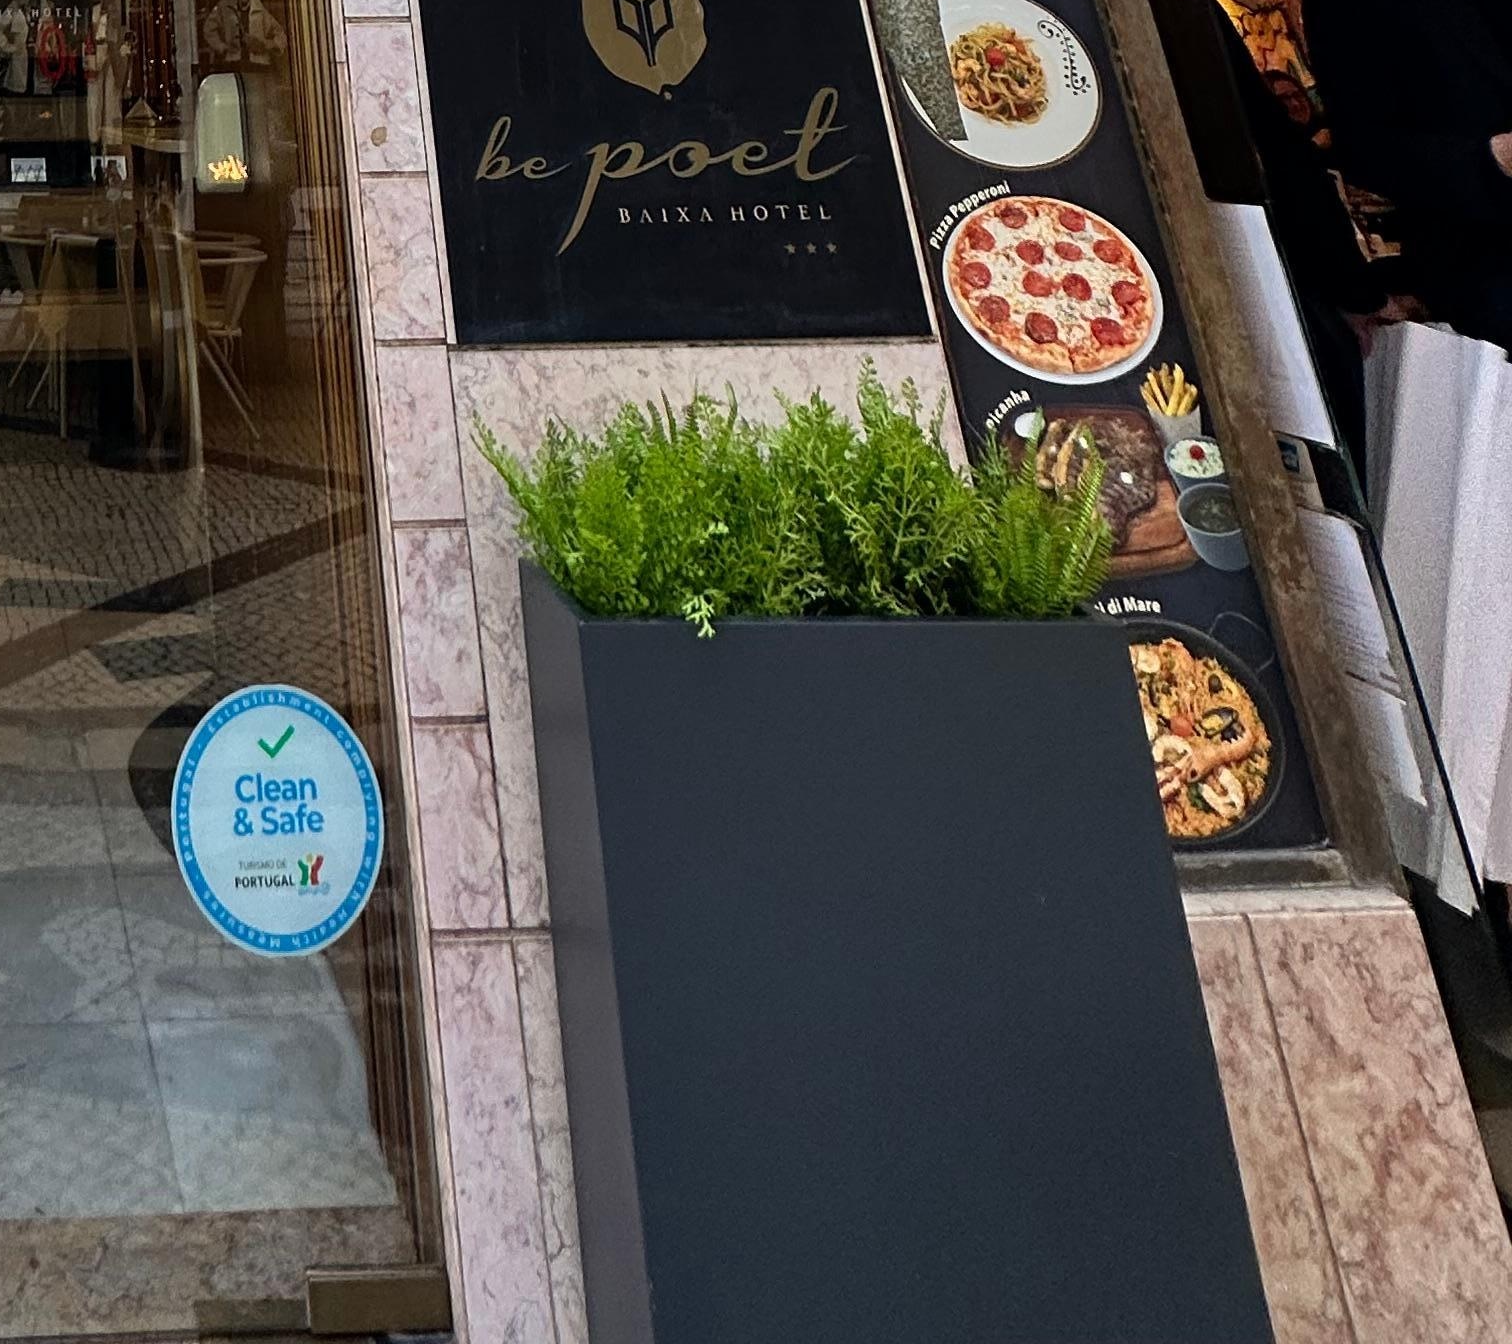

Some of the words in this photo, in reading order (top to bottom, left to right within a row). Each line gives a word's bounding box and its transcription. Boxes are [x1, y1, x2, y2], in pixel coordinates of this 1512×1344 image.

[31, 7, 83, 18] HOTEL
[476, 116, 572, 183] be
[557, 86, 858, 256] poet
[619, 206, 715, 224] BAIXA
[731, 204, 832, 222] HOTEL
[929, 214, 954, 250] Pizza
[949, 179, 1011, 218] Pepperoni
[1122, 596, 1161, 614] Mare
[235, 773, 317, 803] Clean
[234, 808, 253, 836] &
[261, 803, 324, 835] Safe
[235, 873, 296, 889] PORTUGAL
